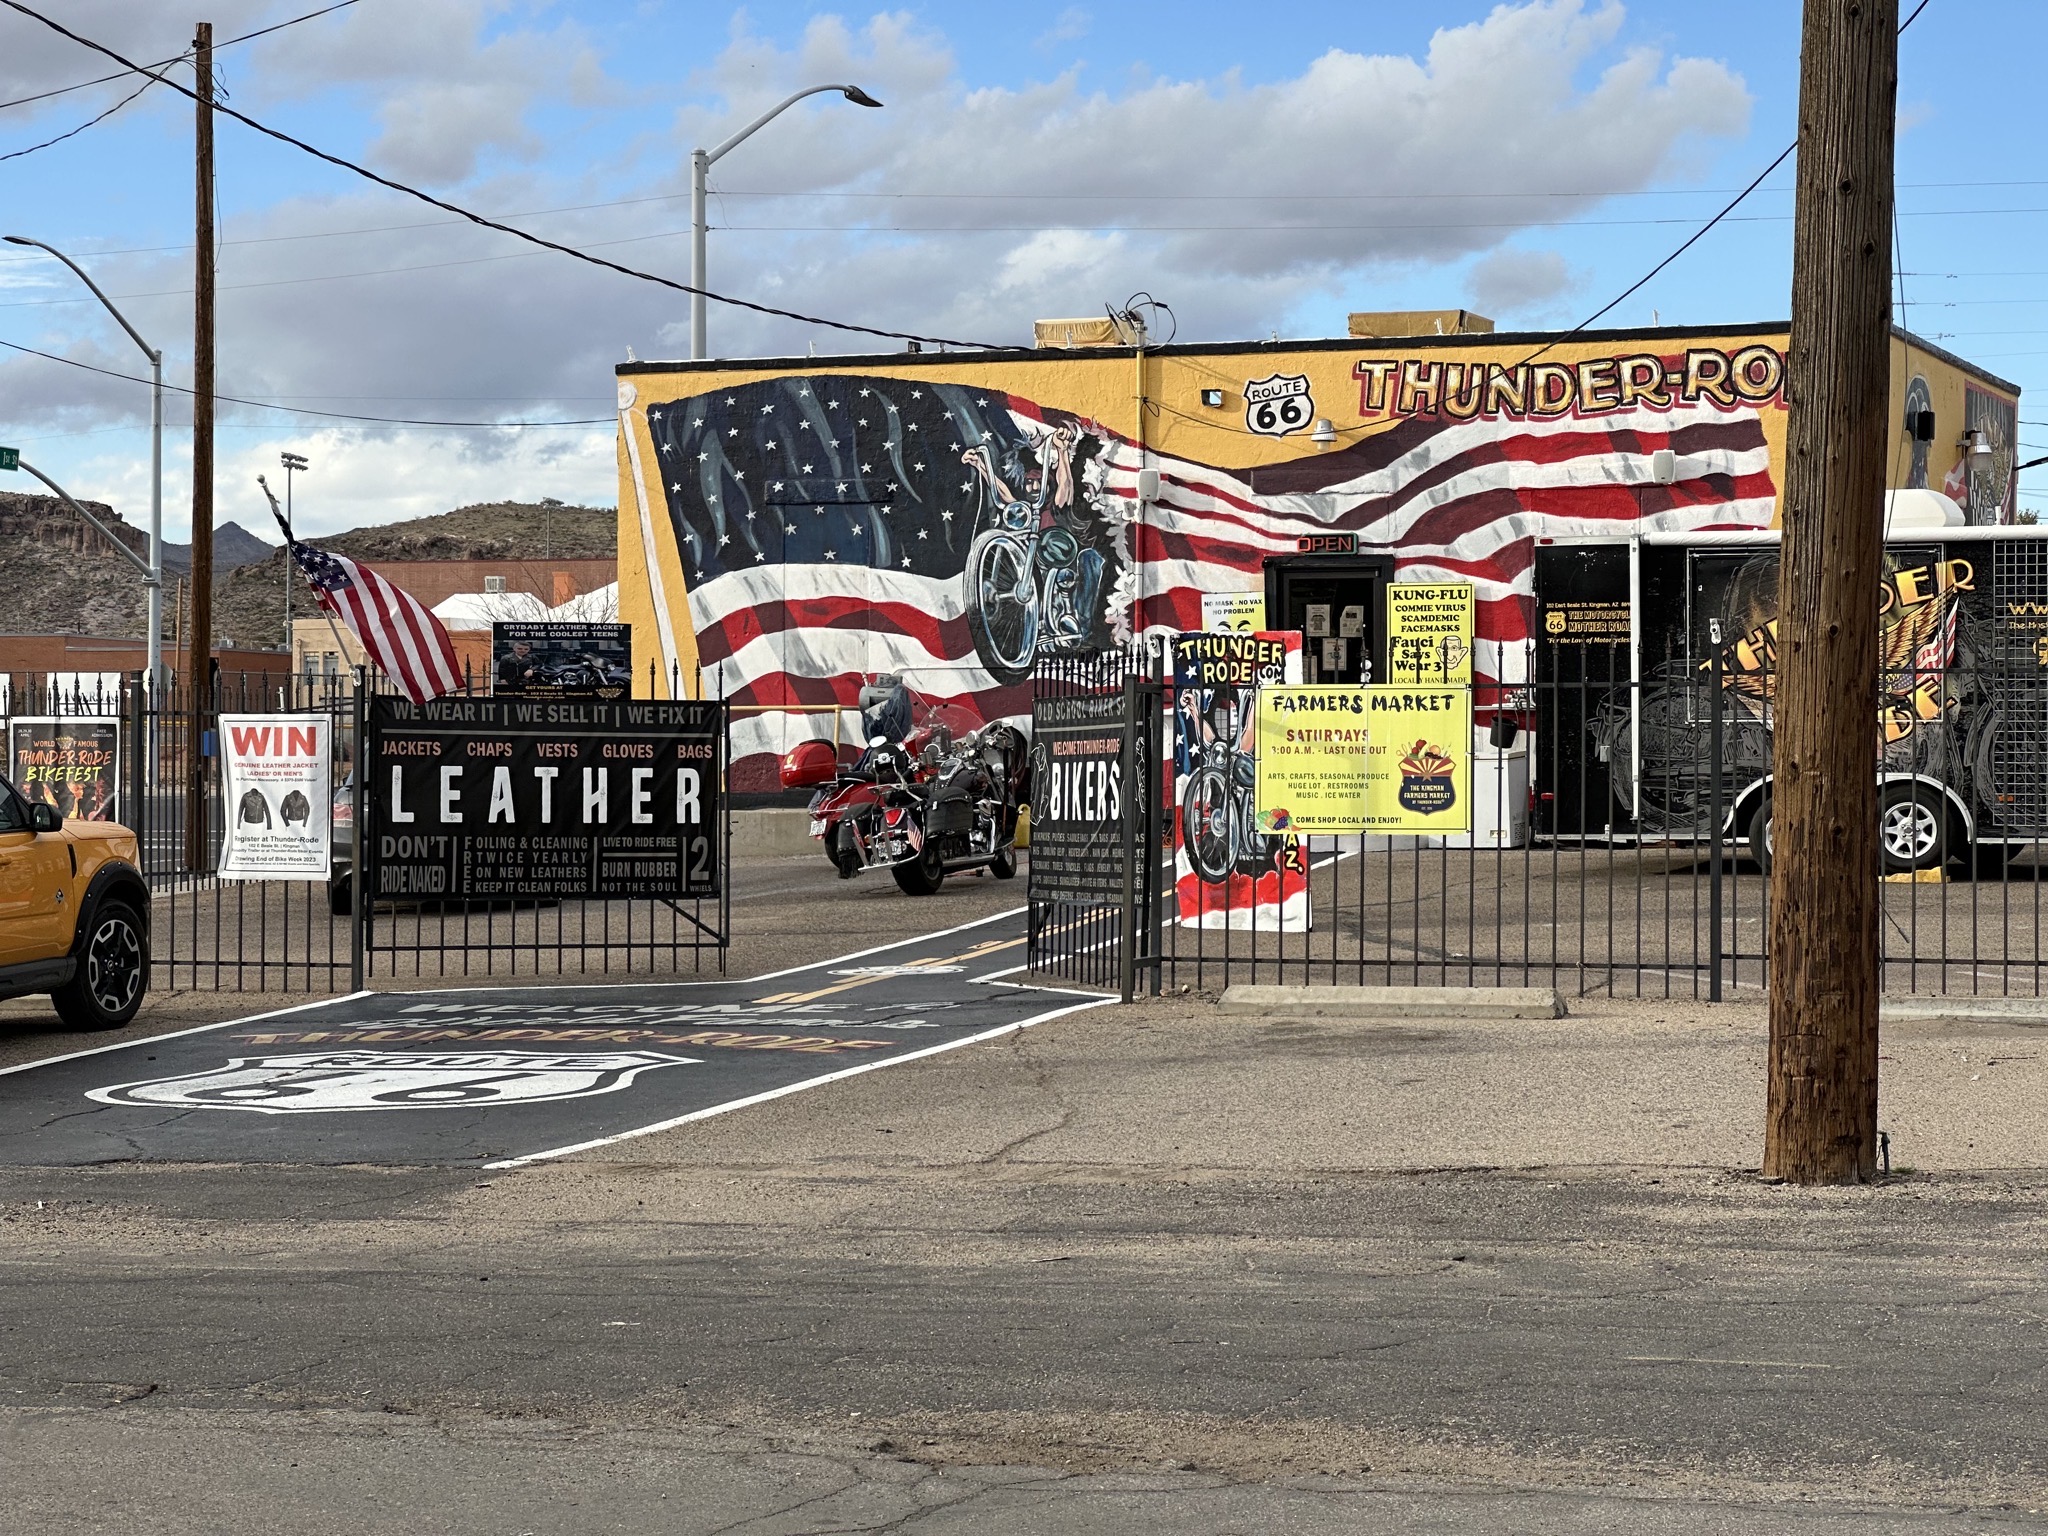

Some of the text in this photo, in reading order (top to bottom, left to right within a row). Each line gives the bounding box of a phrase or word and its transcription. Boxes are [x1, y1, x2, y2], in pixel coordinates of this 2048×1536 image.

[1353, 345, 1788, 420] THUNDER-RO
[1252, 381, 1302, 401] ROUTE
[1256, 398, 1302, 429] 66
[1297, 536, 1352, 552] OPEN
[1392, 589, 1468, 601] KUNG-FLU
[1223, 607, 1255, 615] PROBLEM
[1395, 604, 1433, 612] COMMIE
[1568, 610, 1631, 620] THE MOTORCYCL
[1401, 614, 1460, 622] SCAMDEMIC
[1549, 620, 1563, 630] 66
[1401, 624, 1460, 632] FACEMASKS
[1568, 621, 1607, 632] MOTHER
[1391, 636, 1434, 648] Fauci
[1179, 636, 1283, 664] THUNDER
[1401, 649, 1431, 660] Says
[1203, 661, 1252, 684] RODE
[1395, 660, 1442, 671] Wear 3
[1273, 694, 1455, 714] FARMERS MARKET
[393, 702, 704, 725] WE WEAR IT WE SELL IT WE FIX IT
[1037, 702, 1053, 721] OLD
[231, 726, 317, 757] WIN
[1286, 729, 1369, 742] SATURDAYS
[381, 740, 713, 759] JACKETS CHAPS VESTS GLOVES BAGS
[1053, 738, 1120, 756] WELCOME TO THUNDER-RODE
[1294, 745, 1387, 755] A.M. LAST ONE OUT
[18, 750, 113, 765] THUNDER-RODE
[24, 766, 103, 783] BIKEFEST
[391, 765, 701, 824] LEATHER
[1049, 760, 1121, 821] BIKERS
[270, 835, 319, 844] Thunder-Rode
[476, 837, 588, 849] OILING & CLEANING
[603, 837, 677, 847] LIVE TO RIDE FREE
[381, 836, 448, 858] DON'T
[477, 852, 588, 863] TWICE YEARLY
[690, 836, 709, 881] 2
[476, 867, 587, 878] ON NEW LEATHERS
[602, 862, 677, 877] BURN RUBBER
[380, 865, 446, 893] RIDE NAKED
[475, 882, 587, 893] KEEP IT CLEAN FOLKS
[602, 882, 677, 892] NOT THE SOUL
[398, 1003, 862, 1013] WELCOME
[230, 1029, 897, 1053] THUNDER-RODE
[300, 1056, 621, 1067] ROUTE
[183, 1071, 549, 1103] 66
